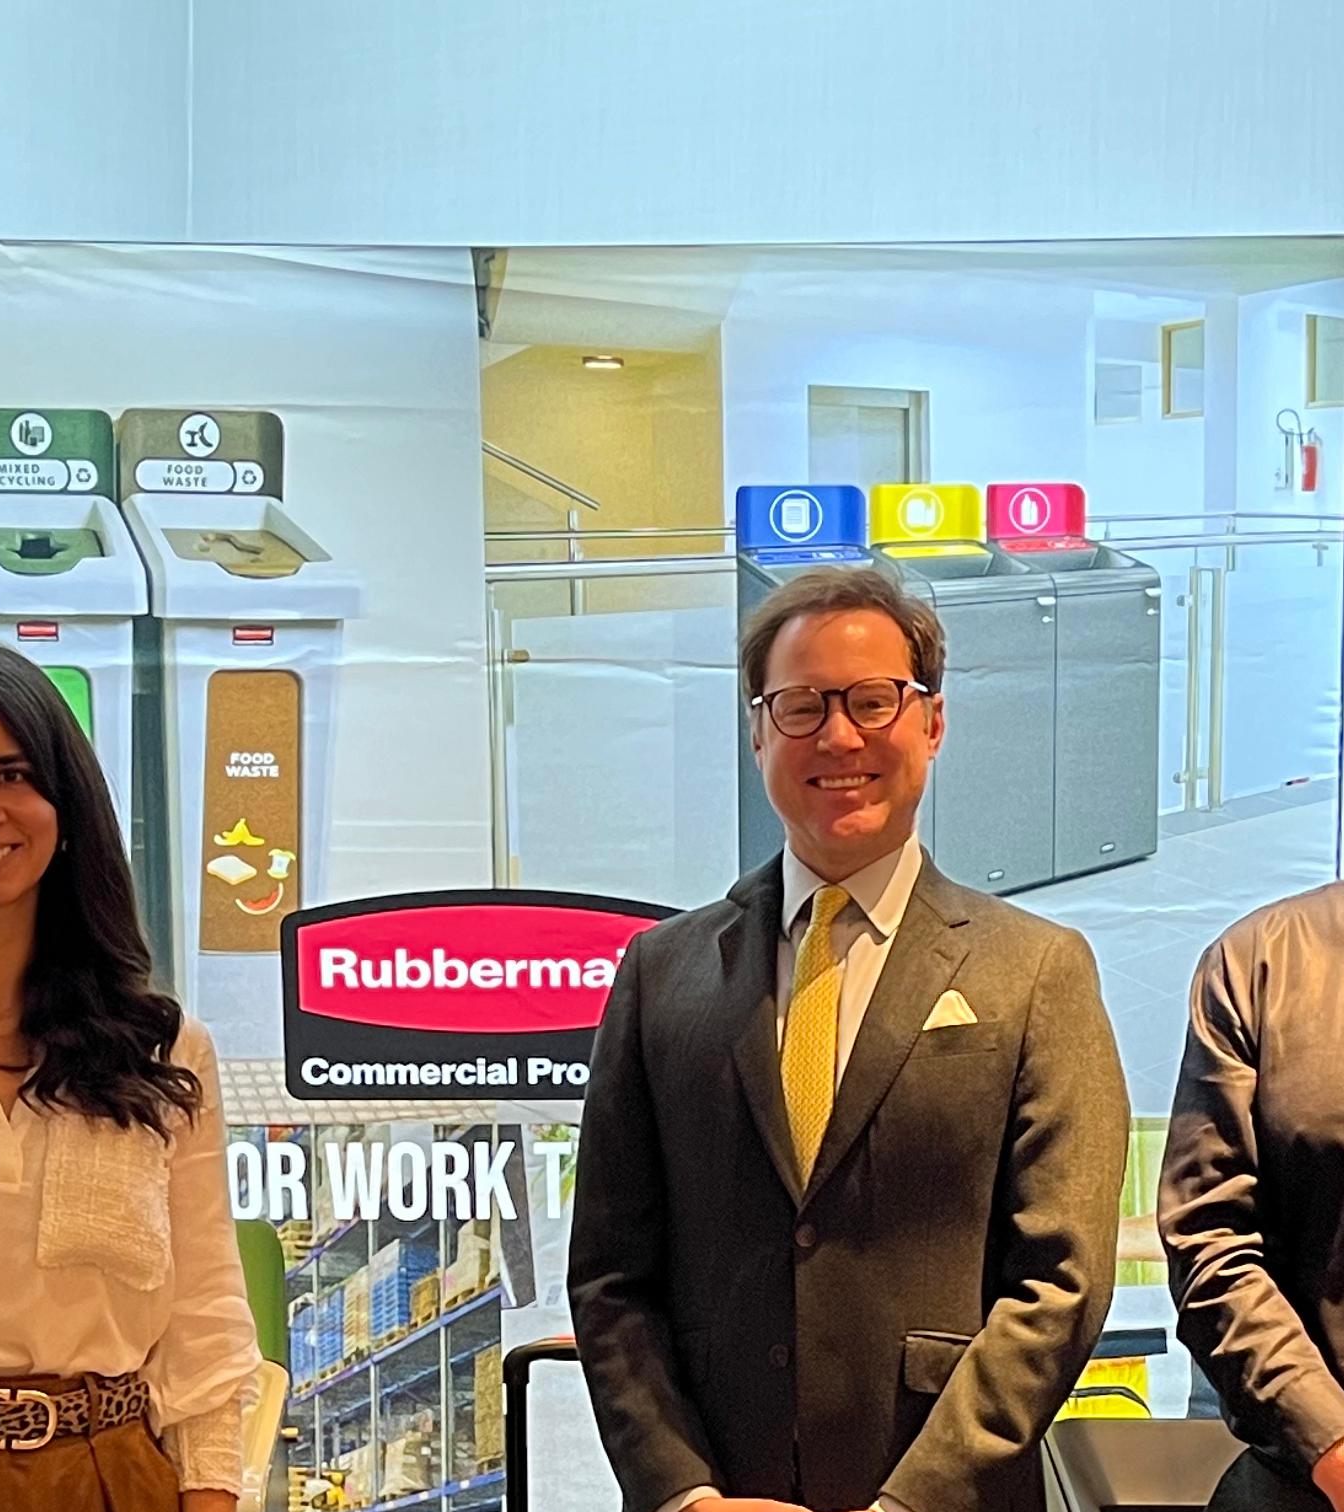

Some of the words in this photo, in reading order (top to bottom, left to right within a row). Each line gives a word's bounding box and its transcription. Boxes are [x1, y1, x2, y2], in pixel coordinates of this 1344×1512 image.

[167, 464, 204, 475] FOOD
[162, 477, 208, 488] WASTE
[230, 752, 275, 765] FOOD
[224, 765, 280, 778] WASTE
[319, 947, 624, 990] Rubberma
[300, 1056, 518, 1087] Commercial
[527, 1056, 591, 1087] Pro
[225, 1141, 308, 1221] OR
[325, 1141, 518, 1222] WORK
[533, 1141, 572, 1219] T
